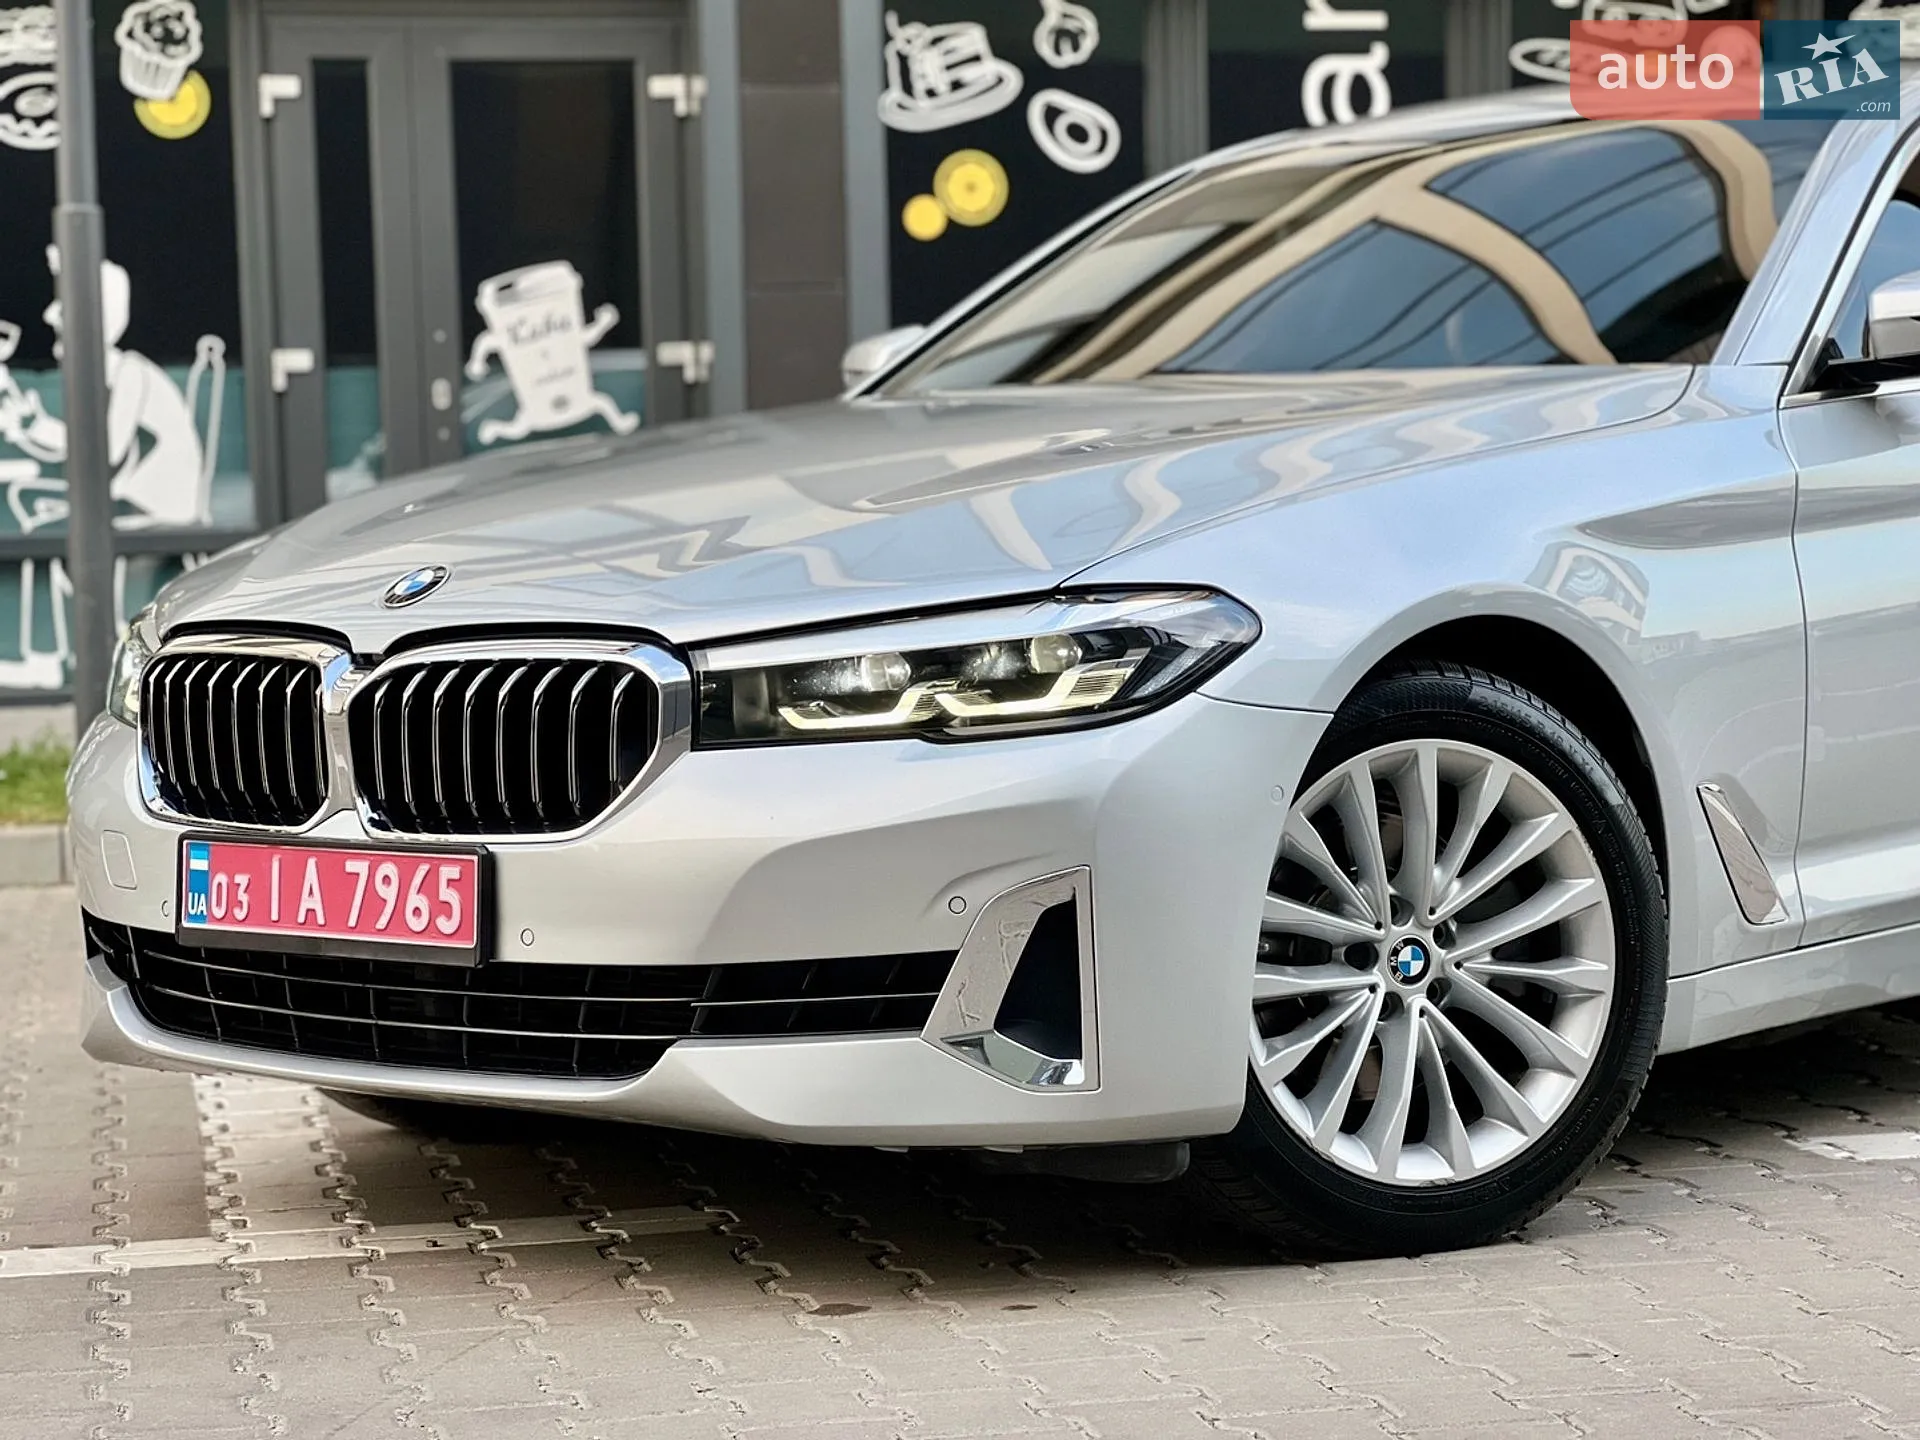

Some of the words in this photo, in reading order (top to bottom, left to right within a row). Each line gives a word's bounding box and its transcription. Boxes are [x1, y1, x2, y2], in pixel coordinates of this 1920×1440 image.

[187, 891, 208, 916] UA
[210, 871, 251, 921] 03
[270, 853, 327, 927] IA
[344, 859, 463, 936] 7965
[1390, 940, 1405, 982] BMW
